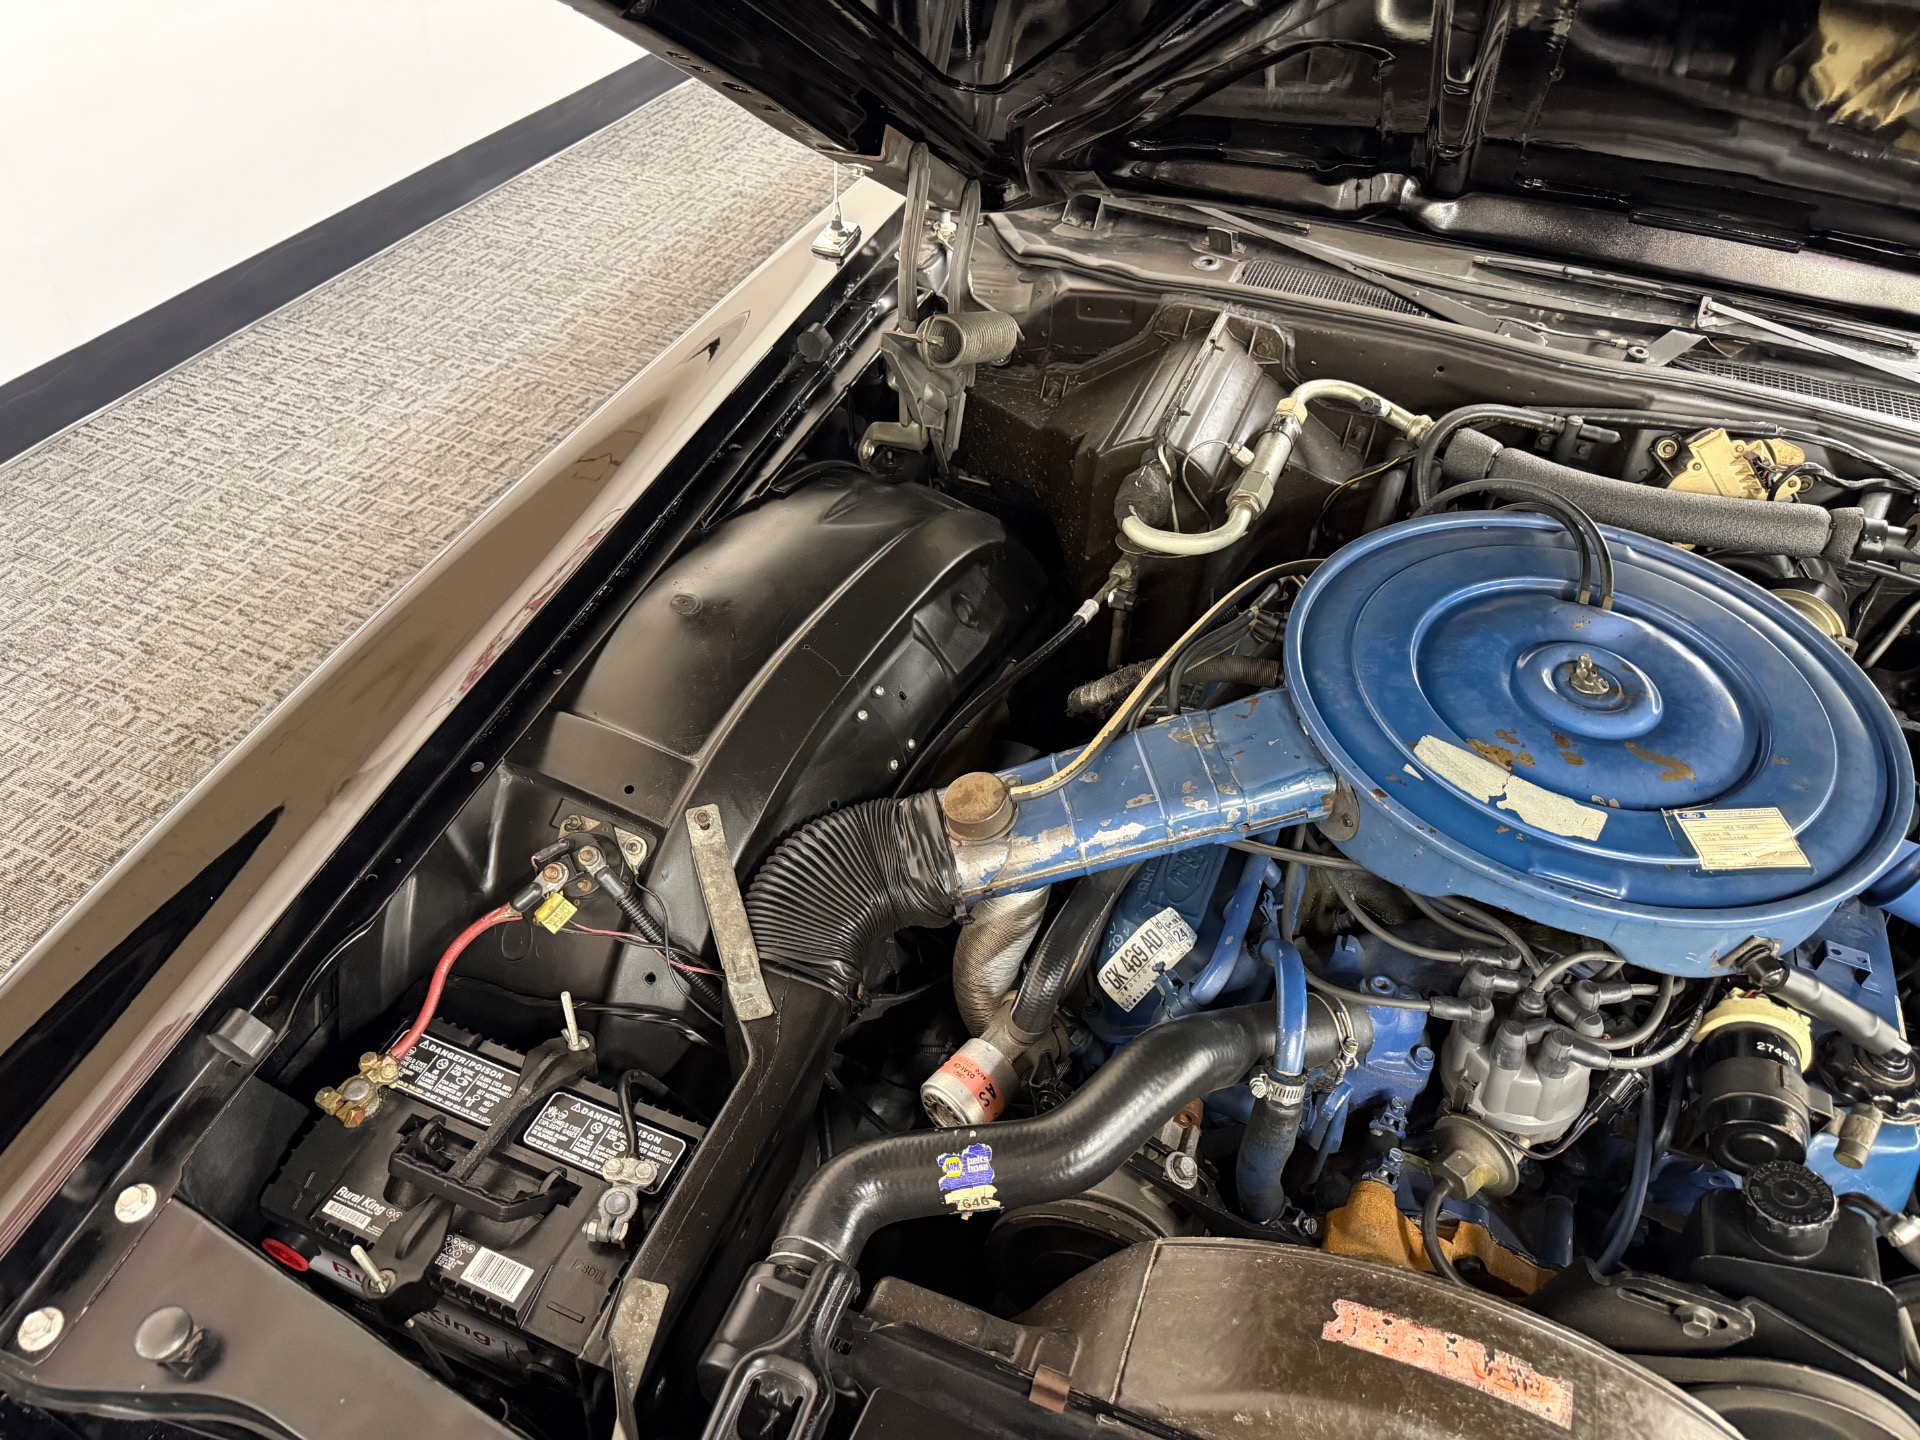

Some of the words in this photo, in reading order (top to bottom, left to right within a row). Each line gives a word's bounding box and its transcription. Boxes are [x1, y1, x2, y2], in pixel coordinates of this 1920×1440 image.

[1173, 927, 1188, 942] 24
[1105, 964, 1128, 990] GK
[1140, 929, 1163, 954] AD
[429, 1044, 504, 1079] DANGER/POISON
[1756, 1041, 1798, 1067] 27490
[580, 1107, 662, 1144] DANGER/ISON
[336, 1186, 365, 1206] Rural
[360, 1197, 386, 1215] King
